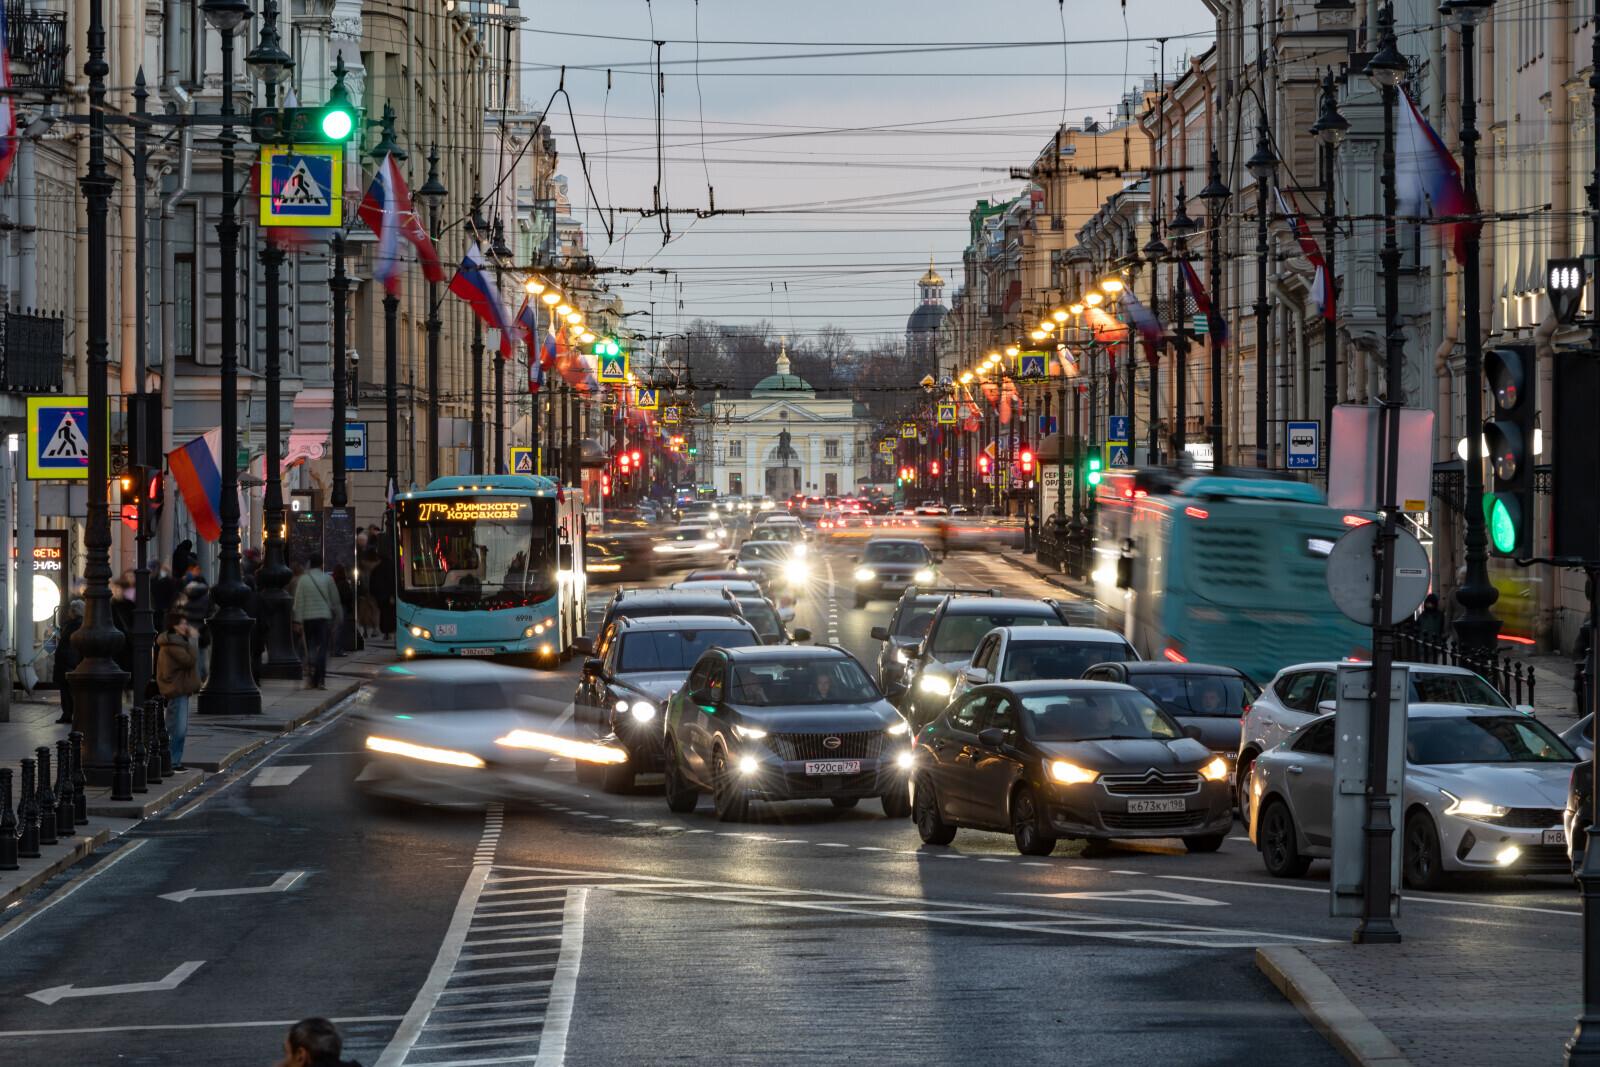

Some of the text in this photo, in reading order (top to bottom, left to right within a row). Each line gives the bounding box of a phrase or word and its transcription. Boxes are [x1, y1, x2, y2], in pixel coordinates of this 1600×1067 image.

[1044, 470, 1073, 479] СЕРЕЙ
[419, 503, 432, 521] 27
[447, 511, 518, 520] Корсакова
